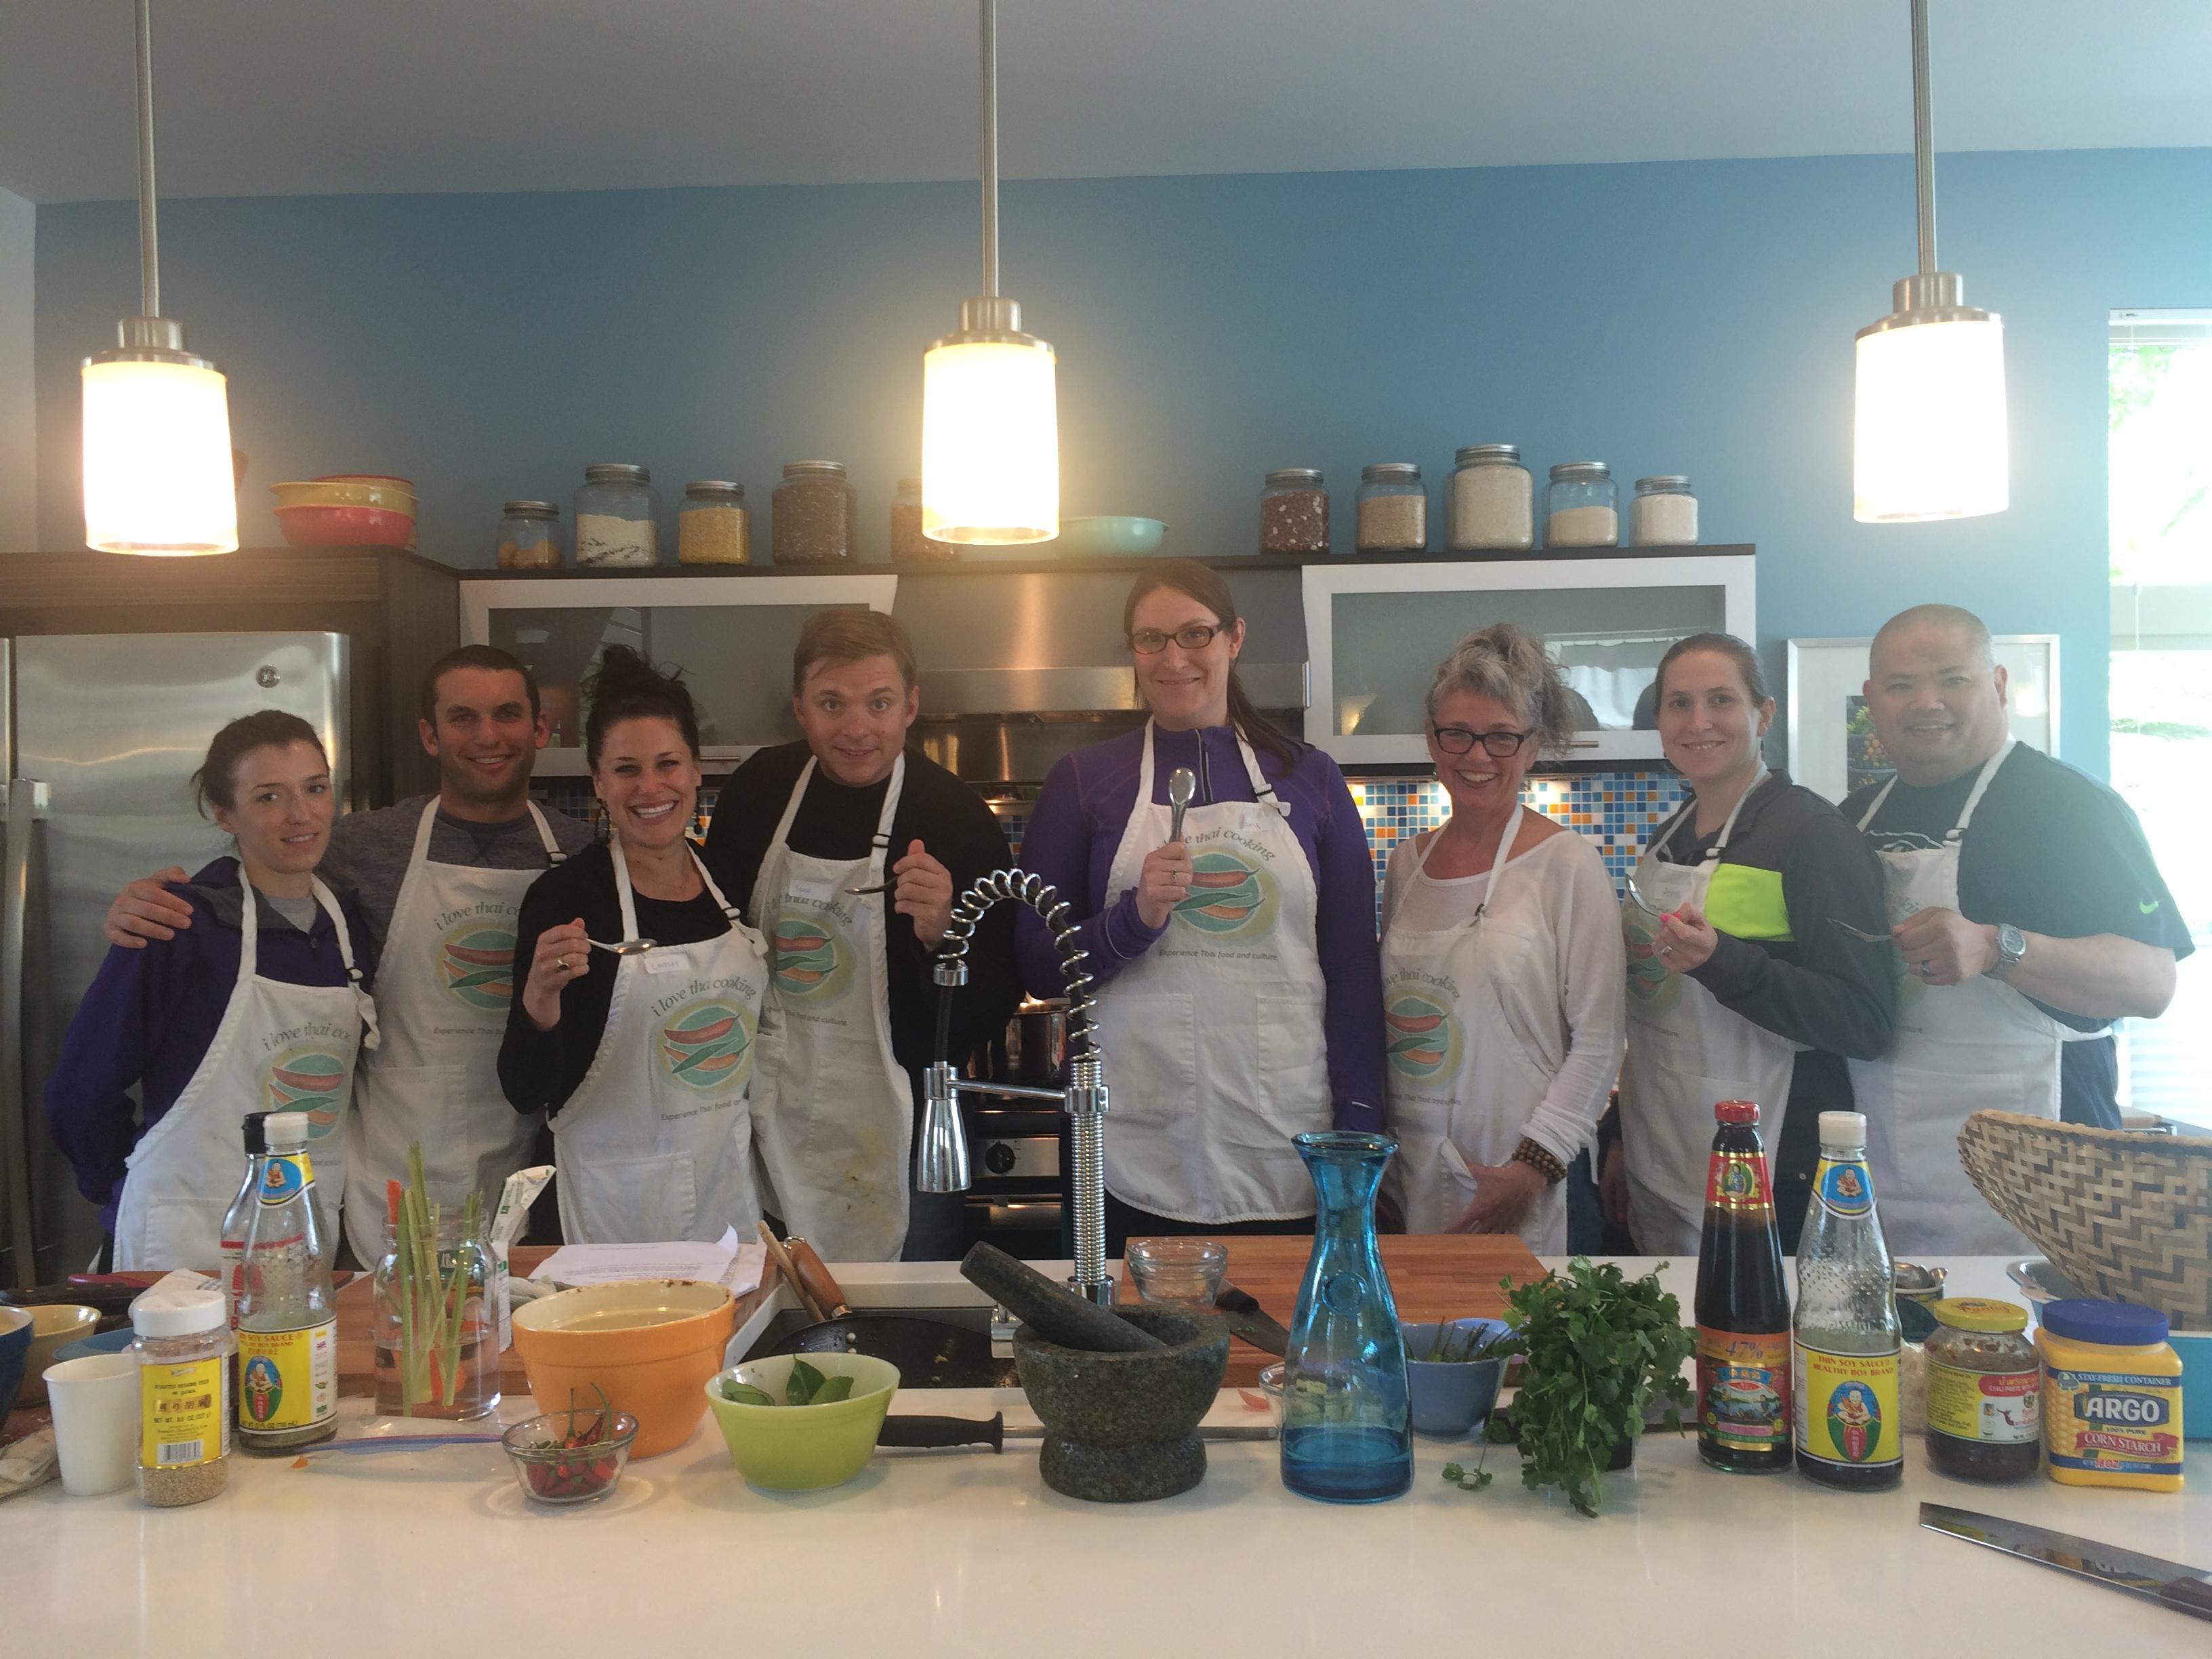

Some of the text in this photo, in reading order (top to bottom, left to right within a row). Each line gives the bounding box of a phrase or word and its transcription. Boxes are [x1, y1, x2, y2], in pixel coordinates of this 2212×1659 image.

[1196, 826, 1275, 861] thai cooking
[434, 918, 443, 930] i
[443, 905, 472, 926] love
[475, 901, 505, 914] thai
[1160, 949, 1199, 958] Experience
[1218, 950, 1235, 960] food
[1399, 968, 1420, 981] thai
[651, 1005, 661, 1017] i
[658, 989, 686, 1011] love
[713, 977, 756, 1000] cooking
[262, 1038, 271, 1051] i
[270, 1027, 301, 1046] love
[304, 1021, 333, 1036] thai
[715, 1100, 731, 1111] food
[248, 1334, 261, 1342] SOY
[264, 1333, 293, 1341] SAUCE
[1725, 1340, 1763, 1359] 47%
[1818, 1355, 1836, 1364] THIN
[1839, 1359, 1856, 1367] SOY
[1813, 1363, 1847, 1375] HEALTHY
[1870, 1368, 1893, 1376] BRAND
[2078, 1373, 2172, 1385] STAY-FRESH CONTAINER
[2084, 1397, 2160, 1422] ARGO
[2084, 1431, 2162, 1453] CORN STARCH
